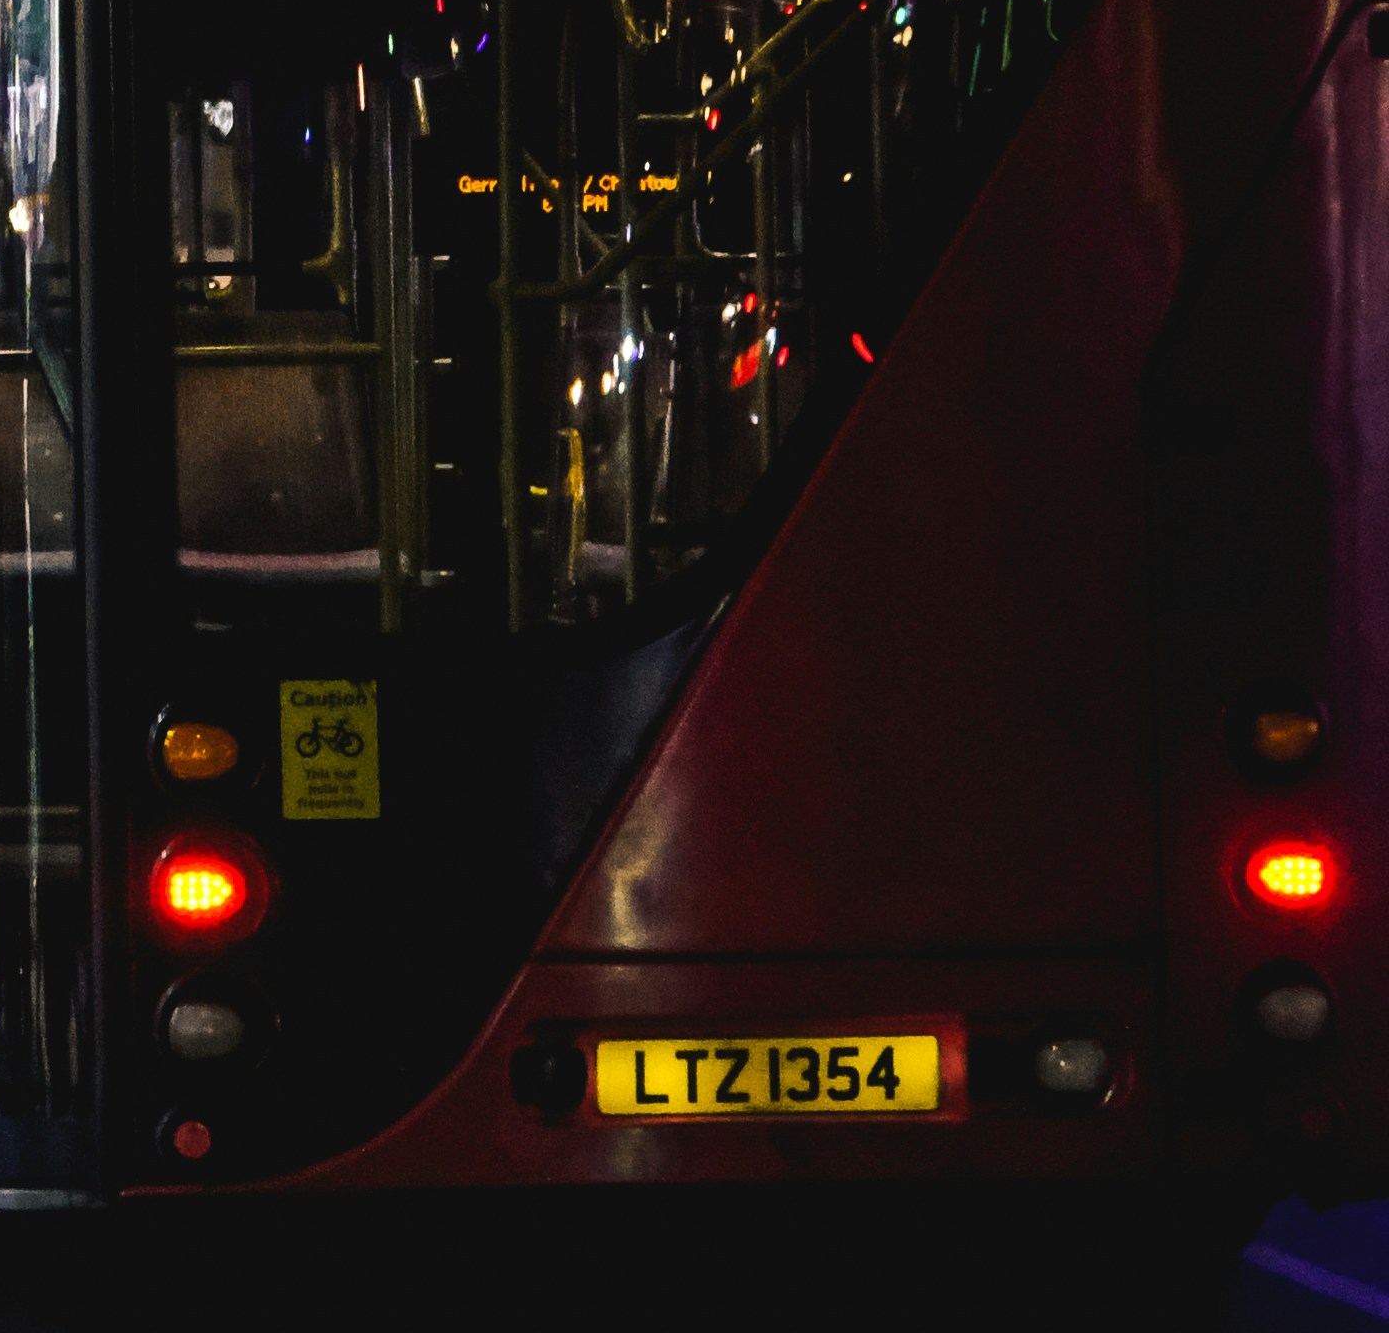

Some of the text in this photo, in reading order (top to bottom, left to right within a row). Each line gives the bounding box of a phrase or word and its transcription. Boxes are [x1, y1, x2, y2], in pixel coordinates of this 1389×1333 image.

[290, 689, 368, 709] Caution
[634, 1046, 901, 1105] LTZ 1354
